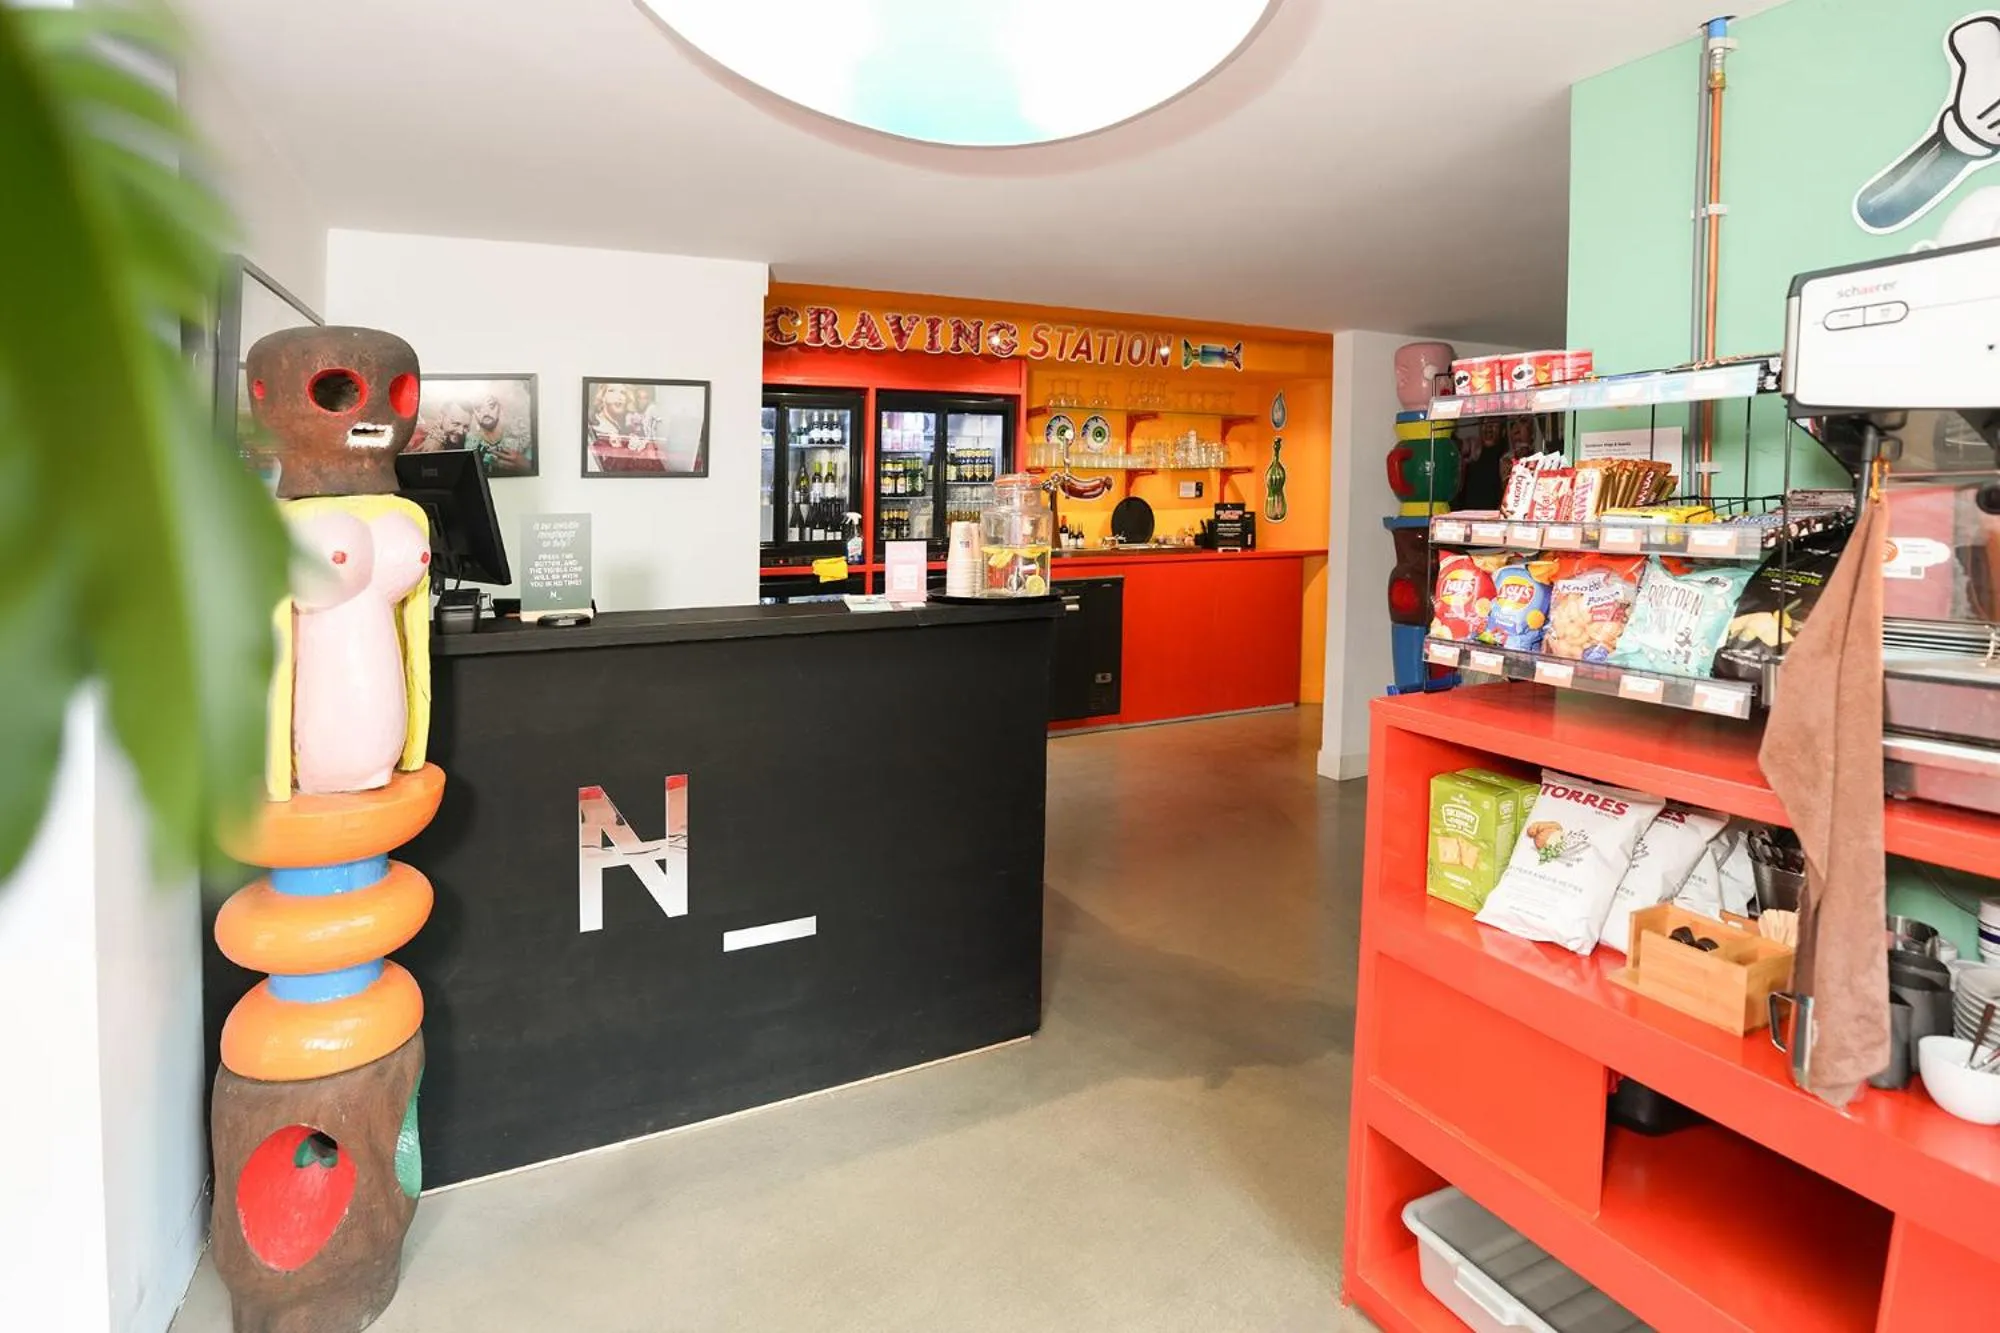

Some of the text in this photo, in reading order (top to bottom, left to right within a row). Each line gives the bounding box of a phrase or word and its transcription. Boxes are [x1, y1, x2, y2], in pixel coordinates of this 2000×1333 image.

[1837, 280, 1898, 299] schaerer
[764, 306, 1174, 367] CRAVING STATION
[1513, 475, 1526, 508] bueno
[530, 580, 544, 588] YOU
[1650, 583, 1704, 616] POPCORN
[1540, 783, 1630, 816] TORRES
